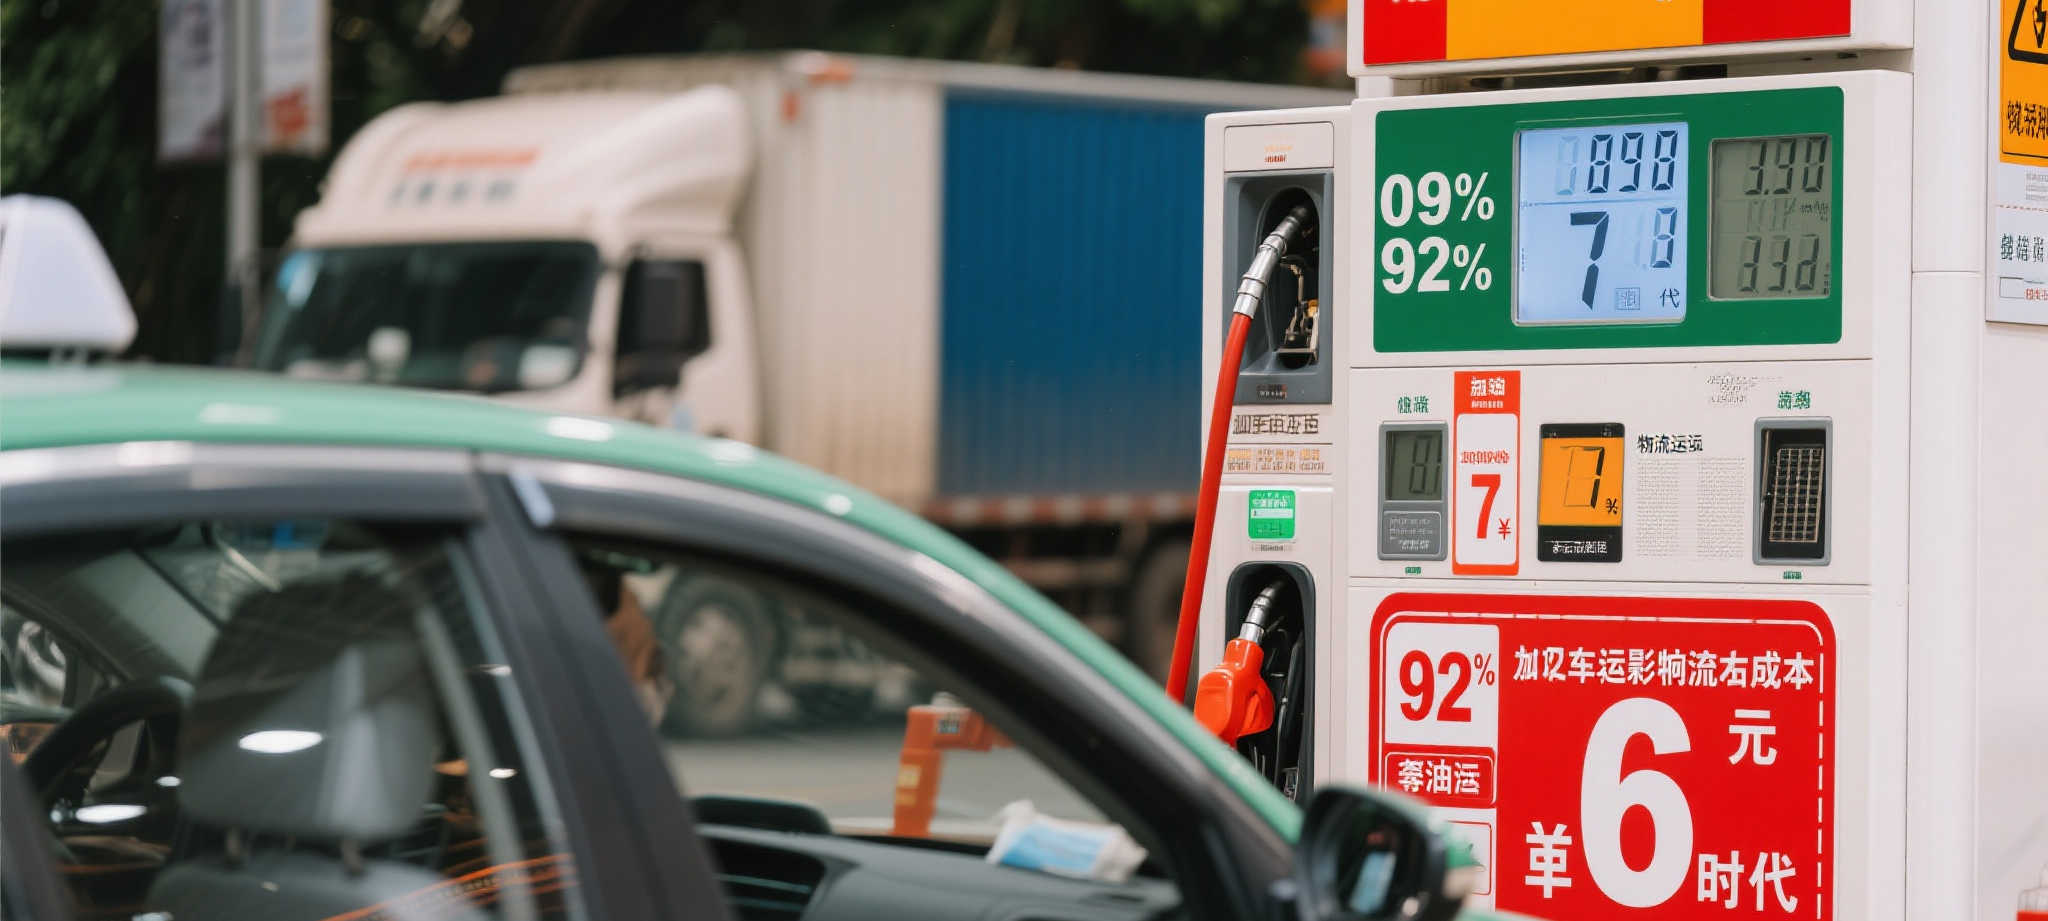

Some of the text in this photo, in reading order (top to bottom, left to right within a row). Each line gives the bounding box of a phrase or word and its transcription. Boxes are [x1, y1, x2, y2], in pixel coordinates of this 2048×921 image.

[1381, 171, 1495, 227] 09%
[1381, 236, 1492, 294] 92%
[1471, 473, 1501, 539] 7
[1399, 650, 1496, 722] 92%
[1728, 709, 1778, 765] 元
[1580, 697, 1694, 908] 6
[1697, 851, 1798, 913] 时代
